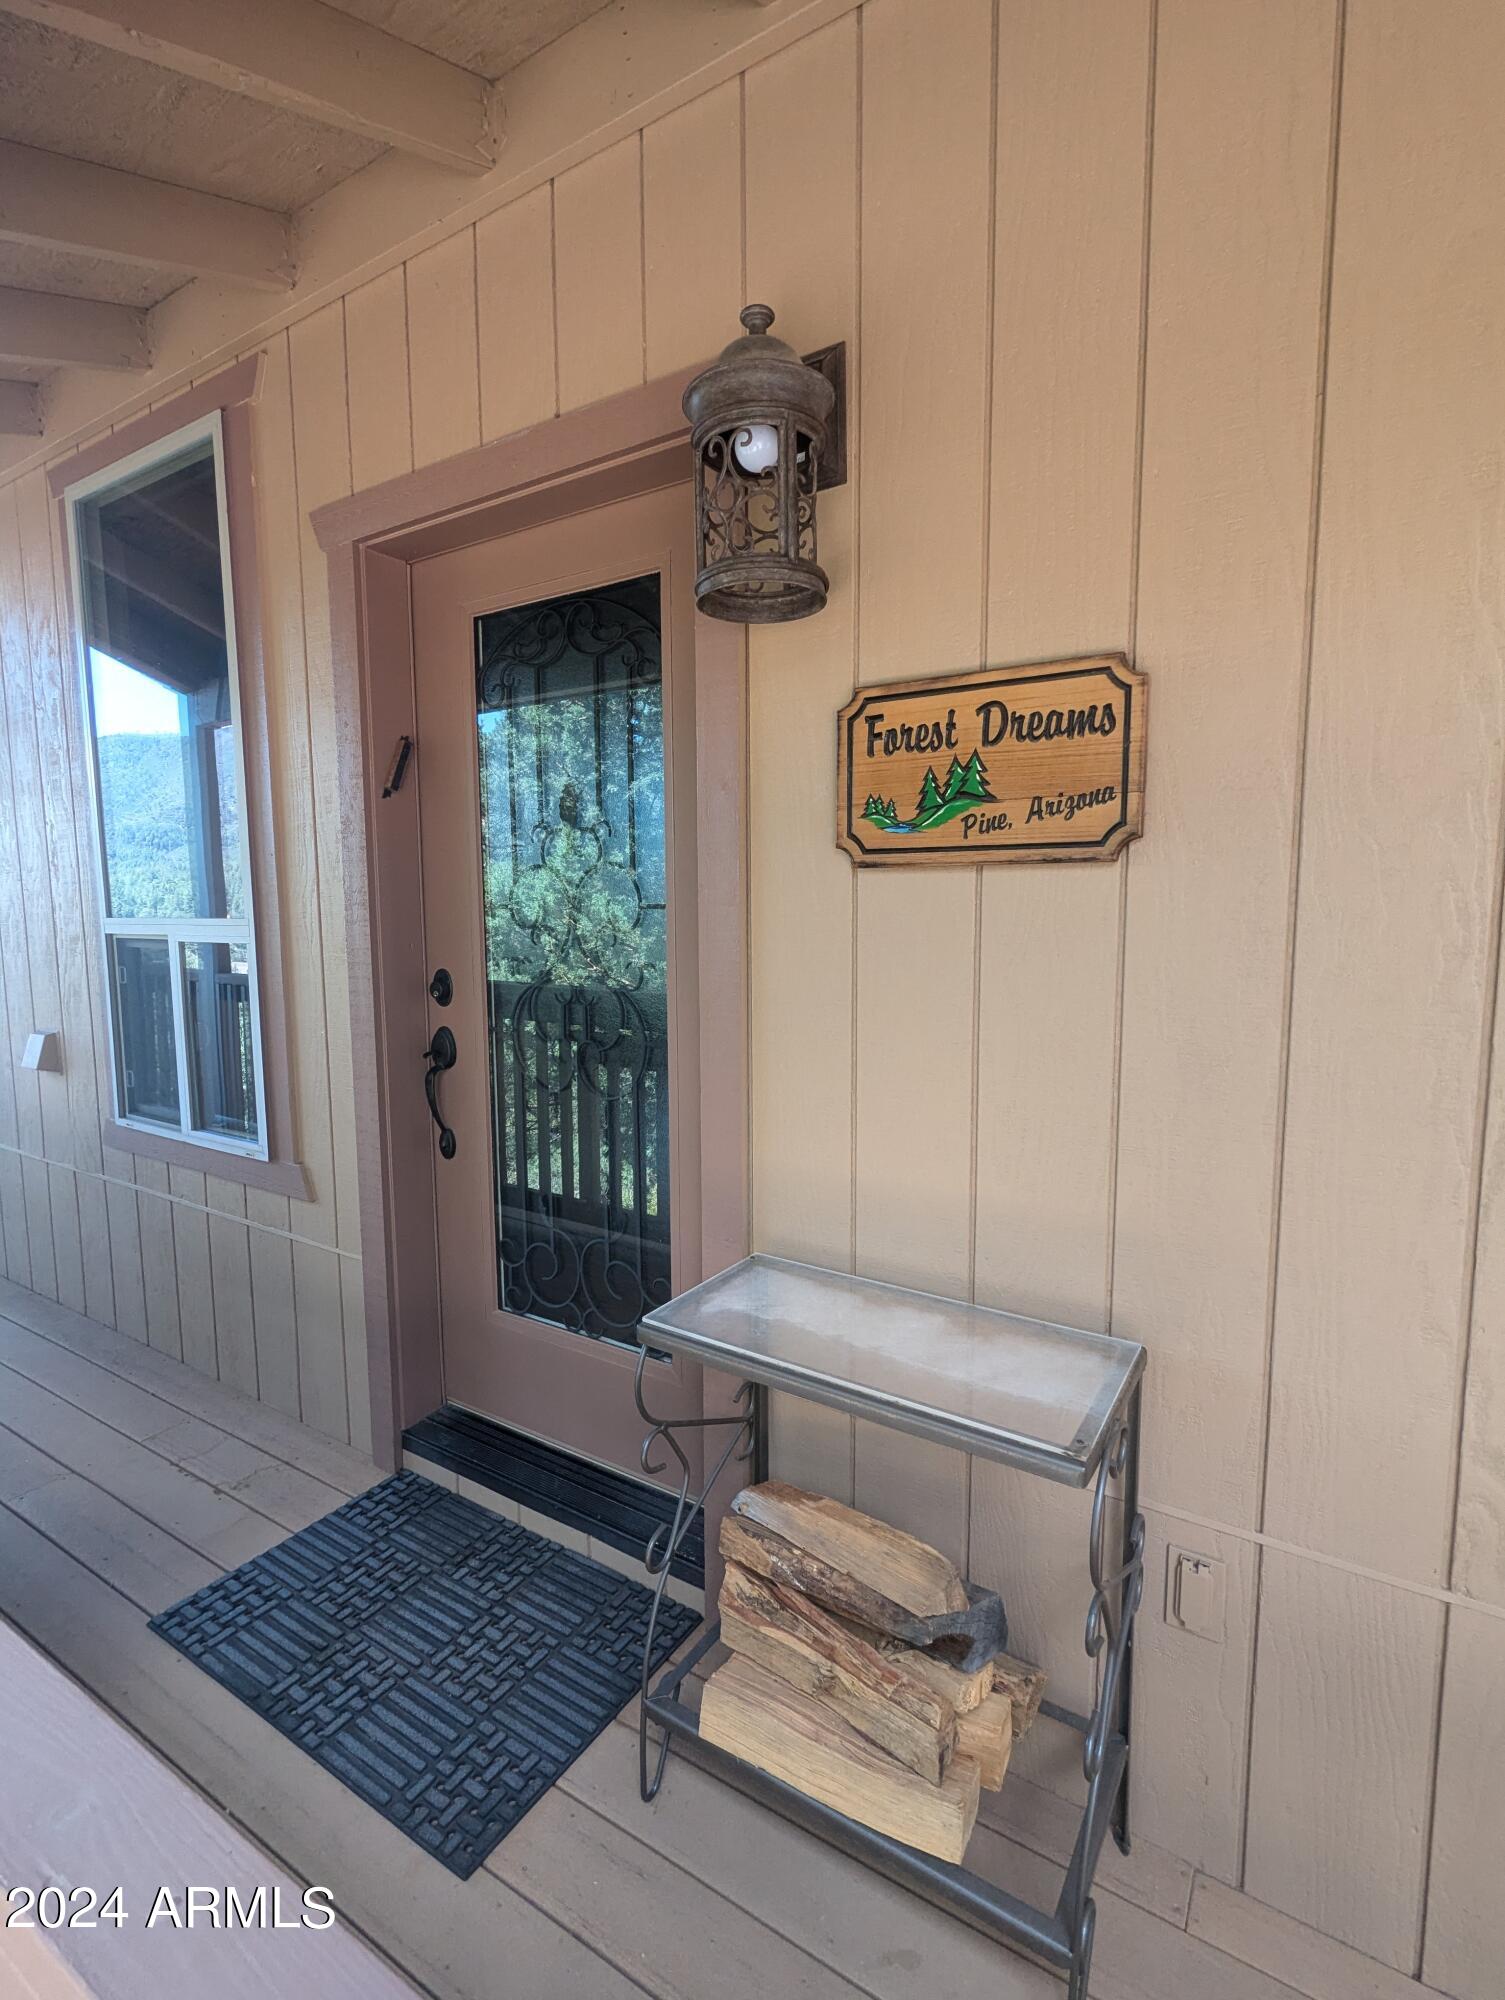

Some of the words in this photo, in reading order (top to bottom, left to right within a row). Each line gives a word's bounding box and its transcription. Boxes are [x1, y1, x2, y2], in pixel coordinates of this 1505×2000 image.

[865, 709, 958, 757] Forest
[976, 700, 1117, 748] Dreams
[961, 812, 1012, 839] Pine,
[1025, 785, 1116, 825] Arizona
